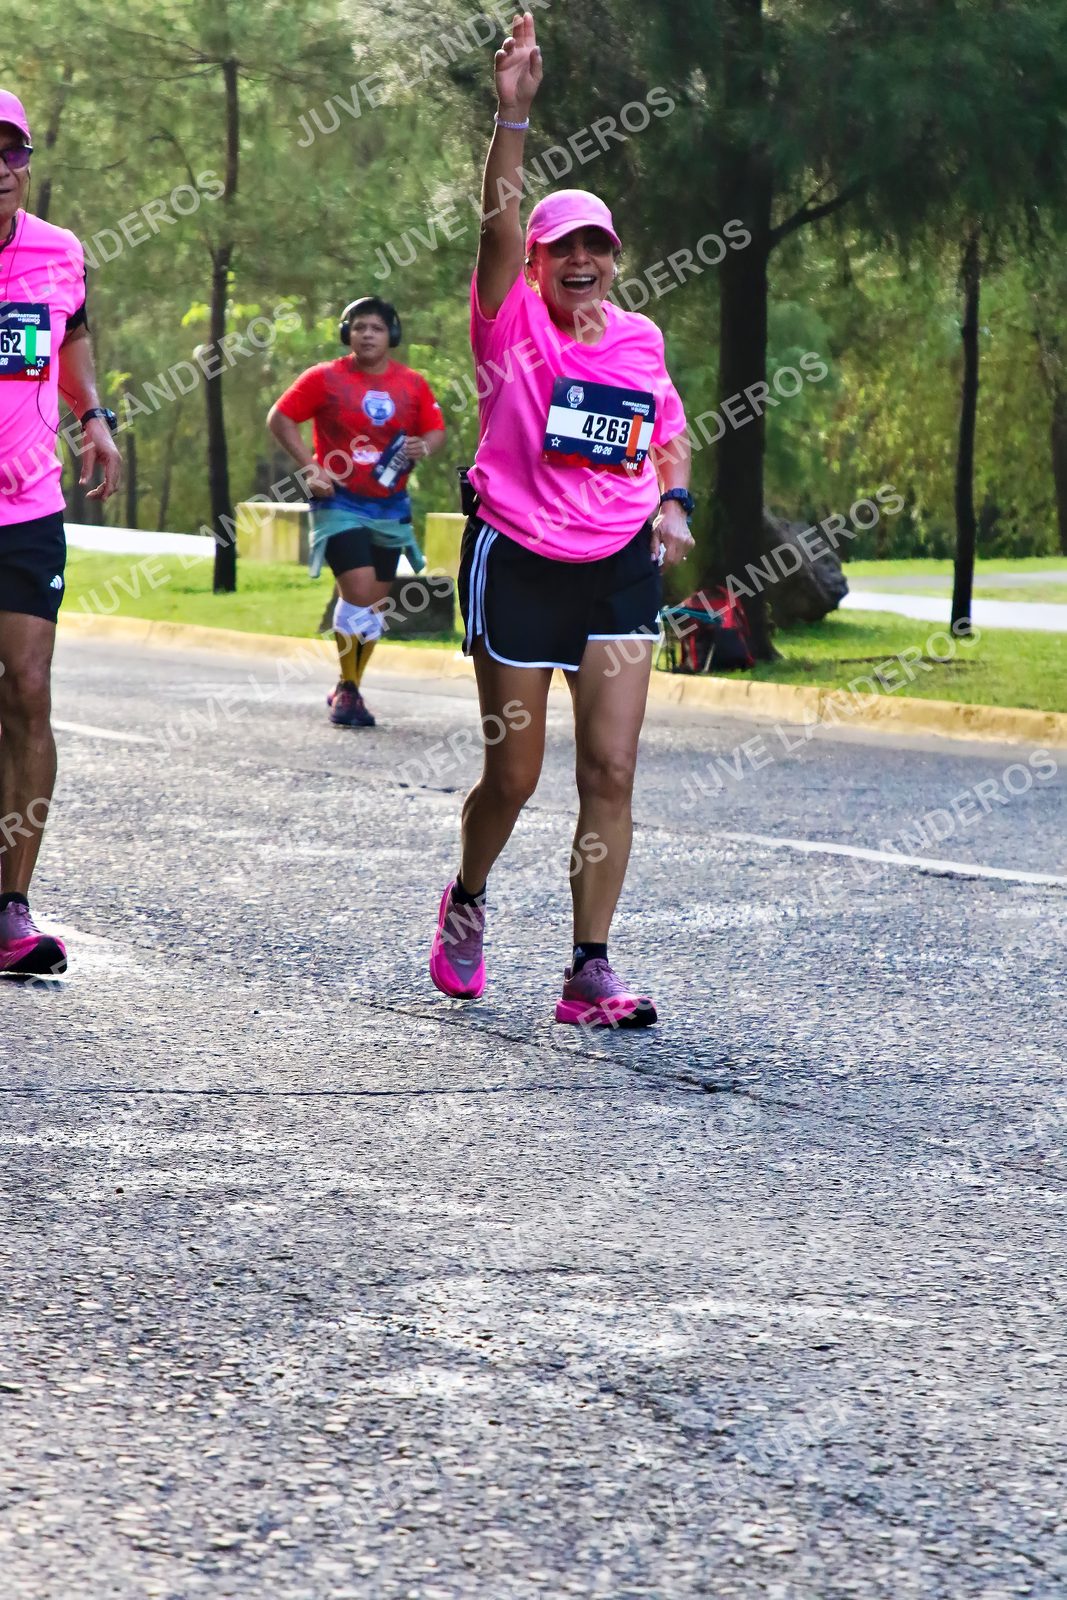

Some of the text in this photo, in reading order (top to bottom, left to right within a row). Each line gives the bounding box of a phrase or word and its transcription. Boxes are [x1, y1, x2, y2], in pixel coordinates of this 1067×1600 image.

[0, 331, 21, 353] 62
[582, 414, 630, 444] 4263
[626, 462, 639, 470] 10K
